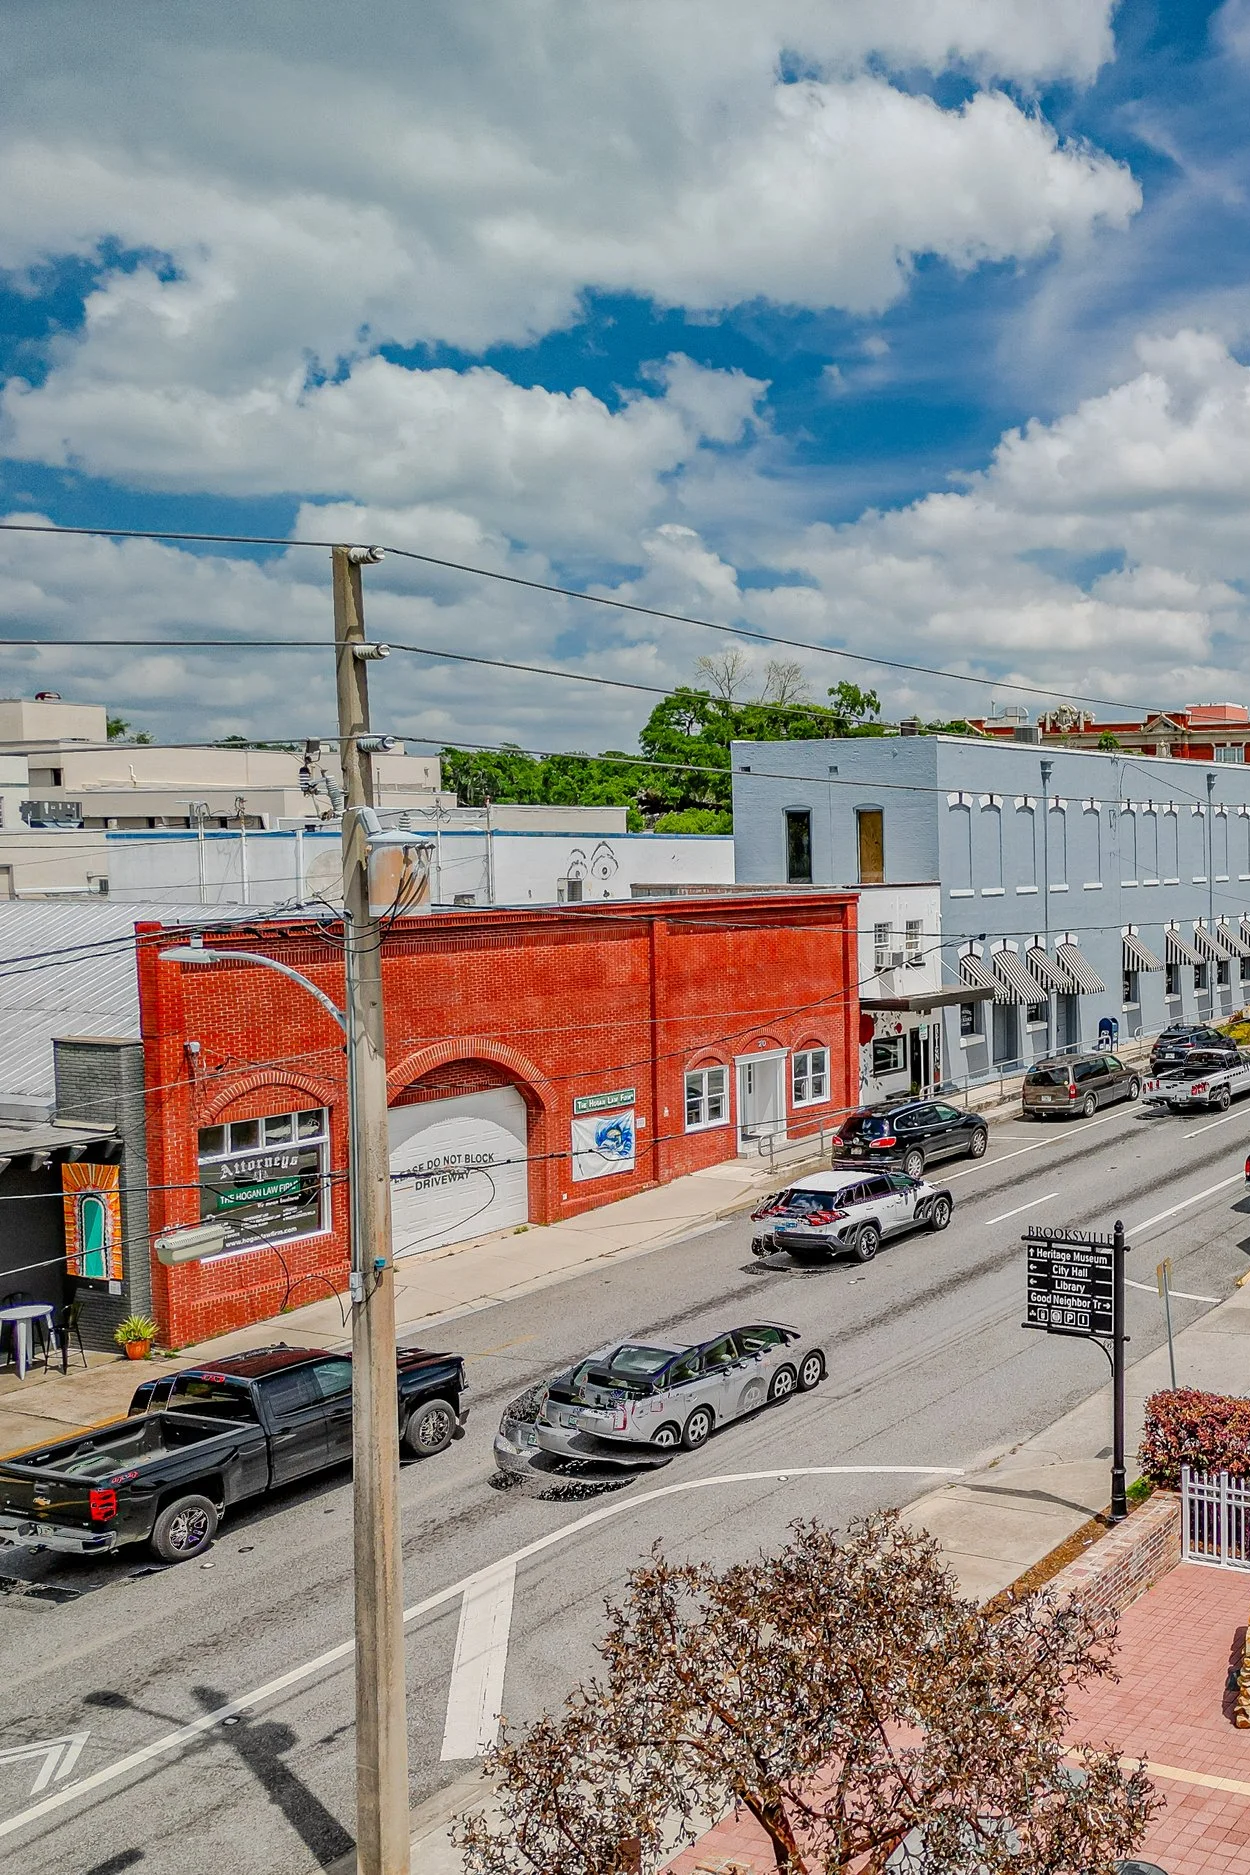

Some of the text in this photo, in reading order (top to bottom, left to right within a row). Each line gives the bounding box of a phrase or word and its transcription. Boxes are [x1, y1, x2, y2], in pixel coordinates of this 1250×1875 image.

[758, 1040, 766, 1048] 20
[220, 1156, 298, 1180] Attorneys
[427, 1158, 441, 1170] DO
[443, 1154, 462, 1165] NOT
[464, 1153, 494, 1163] BLOCK
[415, 1170, 470, 1191] DRIVEWAY
[220, 1194, 235, 1204] THE
[235, 1190, 262, 1201] HOGAN
[262, 1185, 279, 1197] LAW
[225, 1226, 298, 1248] www.hoganlawfirm.com
[1028, 1226, 1113, 1244] BROOKSVILLE
[1036, 1248, 1108, 1264] Heritage Museum
[1052, 1265, 1088, 1277] City Hall
[1055, 1280, 1085, 1294] Library
[1030, 1292, 1101, 1310] Good Neighbor Tr
